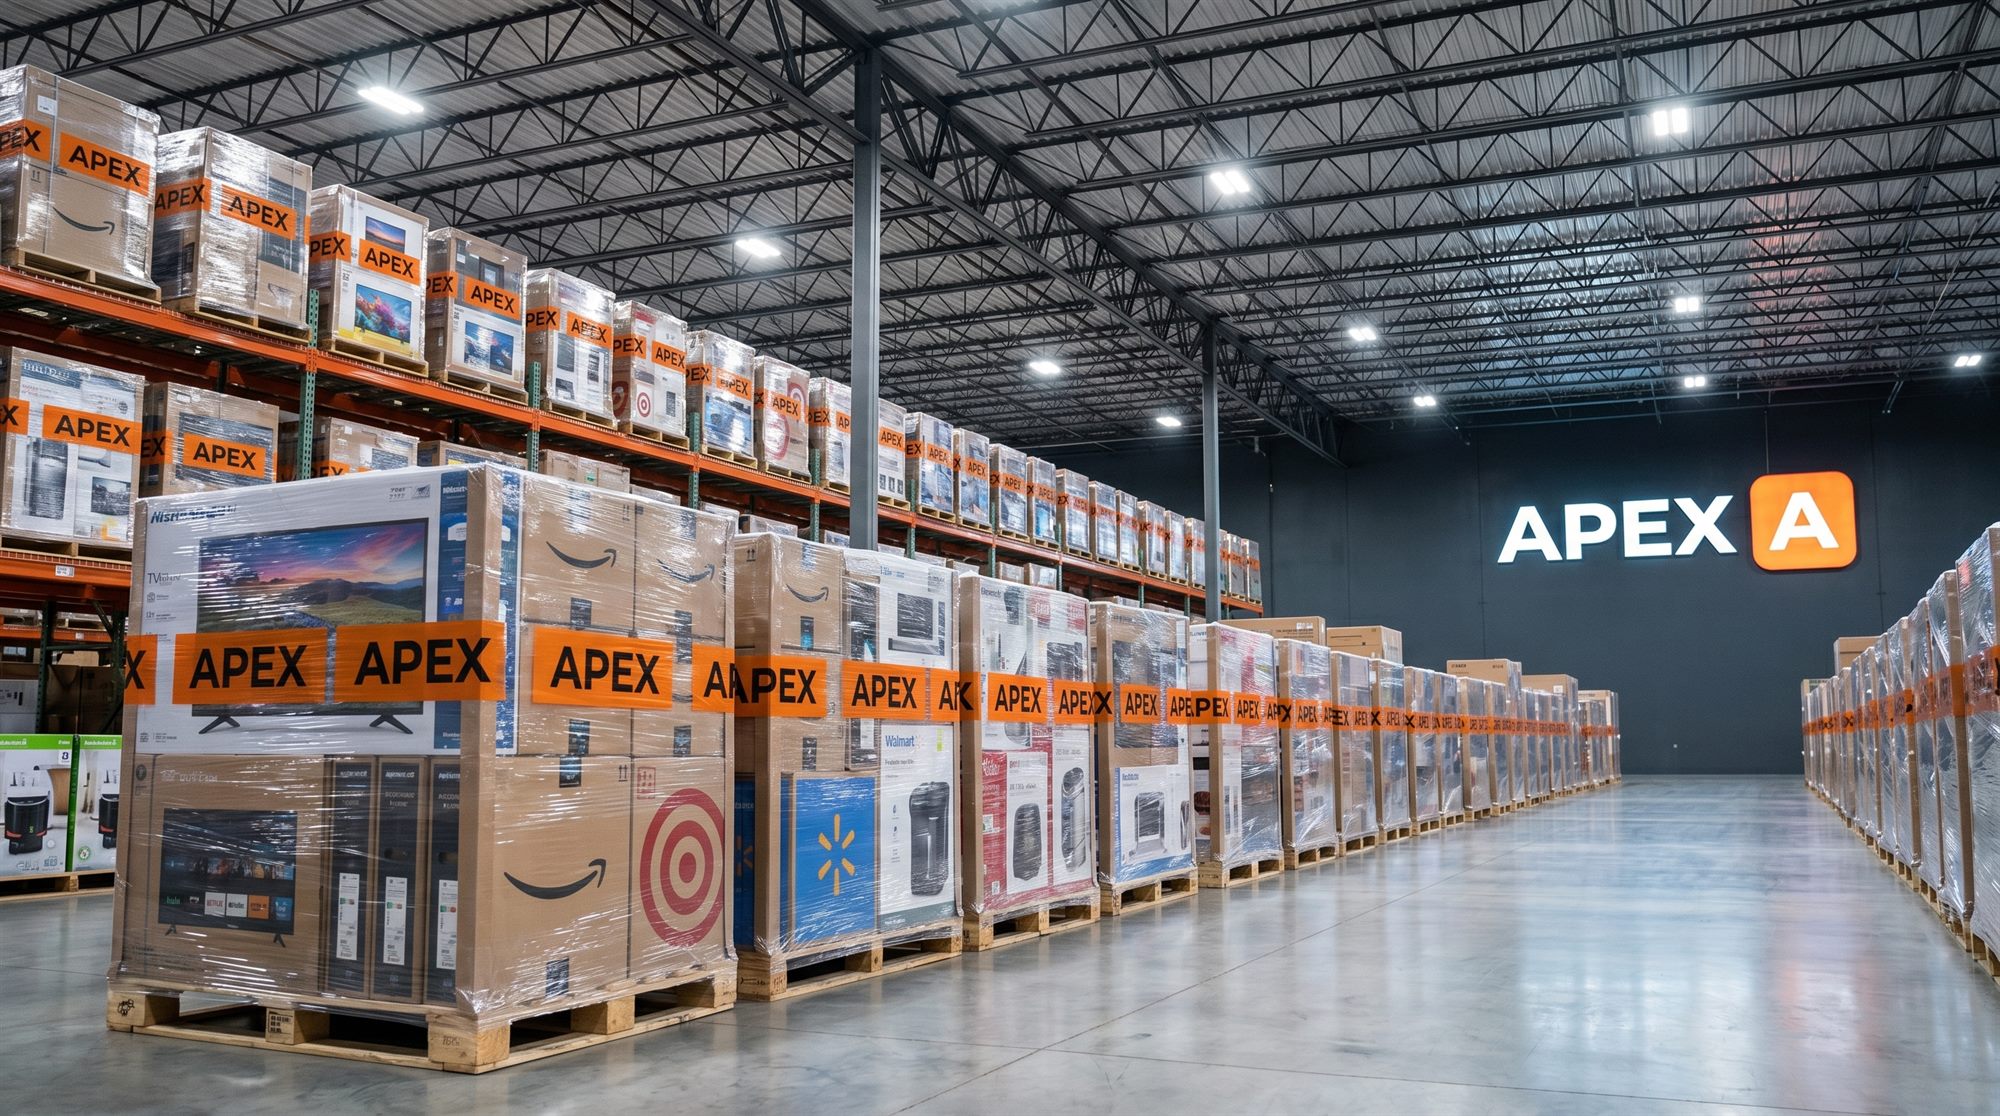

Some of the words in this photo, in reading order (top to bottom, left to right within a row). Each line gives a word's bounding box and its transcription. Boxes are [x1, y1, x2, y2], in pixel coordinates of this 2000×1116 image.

[69, 145, 141, 187] APEX
[228, 195, 289, 232] APEX
[365, 247, 414, 279] APEX
[471, 286, 515, 314] APEX
[656, 347, 685, 369] APEX
[773, 397, 798, 416] APEX
[54, 415, 130, 447] APEX
[880, 431, 902, 448] APEX
[193, 442, 256, 470] APEX
[967, 462, 986, 477] APEX
[1497, 494, 1738, 563] APEX
[1769, 492, 1839, 551] A
[125, 650, 146, 689] X
[189, 645, 307, 689] APEX
[354, 638, 491, 685] APEX
[550, 646, 660, 694] APEX
[852, 673, 917, 709] APEX
[995, 684, 1042, 713] APEX
[1125, 692, 1158, 716] APEX
[1237, 699, 1260, 719] APEX
[885, 735, 915, 747] Walmart
